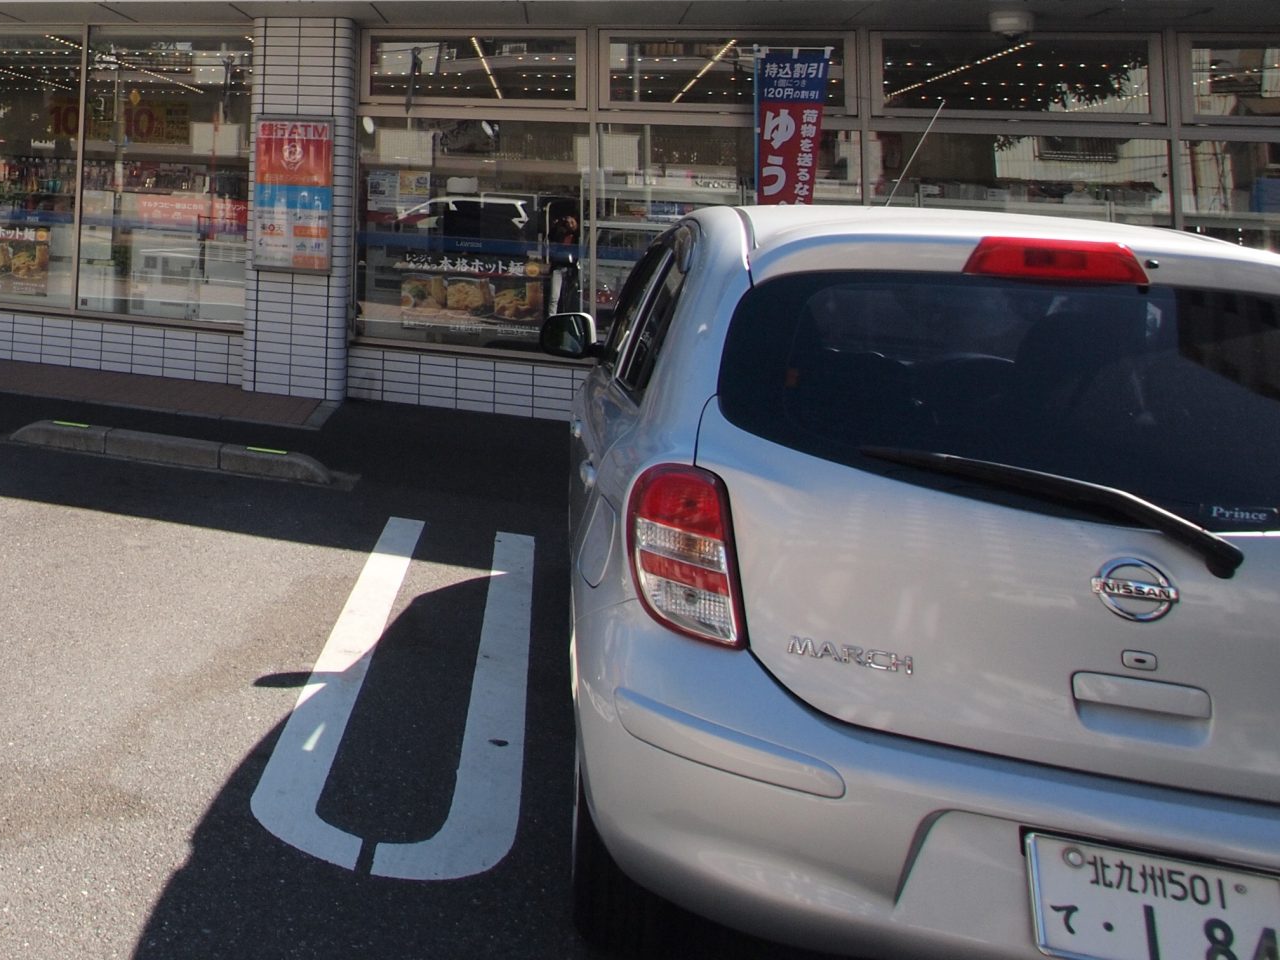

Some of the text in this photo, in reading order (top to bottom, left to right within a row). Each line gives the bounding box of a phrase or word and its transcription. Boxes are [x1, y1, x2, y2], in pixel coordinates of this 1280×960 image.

[765, 62, 824, 78] 持込割引
[764, 87, 819, 99] 120円の割引
[762, 109, 796, 205] ゆう
[439, 256, 525, 276] 本格ホット麺
[1212, 505, 1268, 521] Prince
[1102, 581, 1171, 599] NISSAN
[787, 635, 913, 675] MARCH
